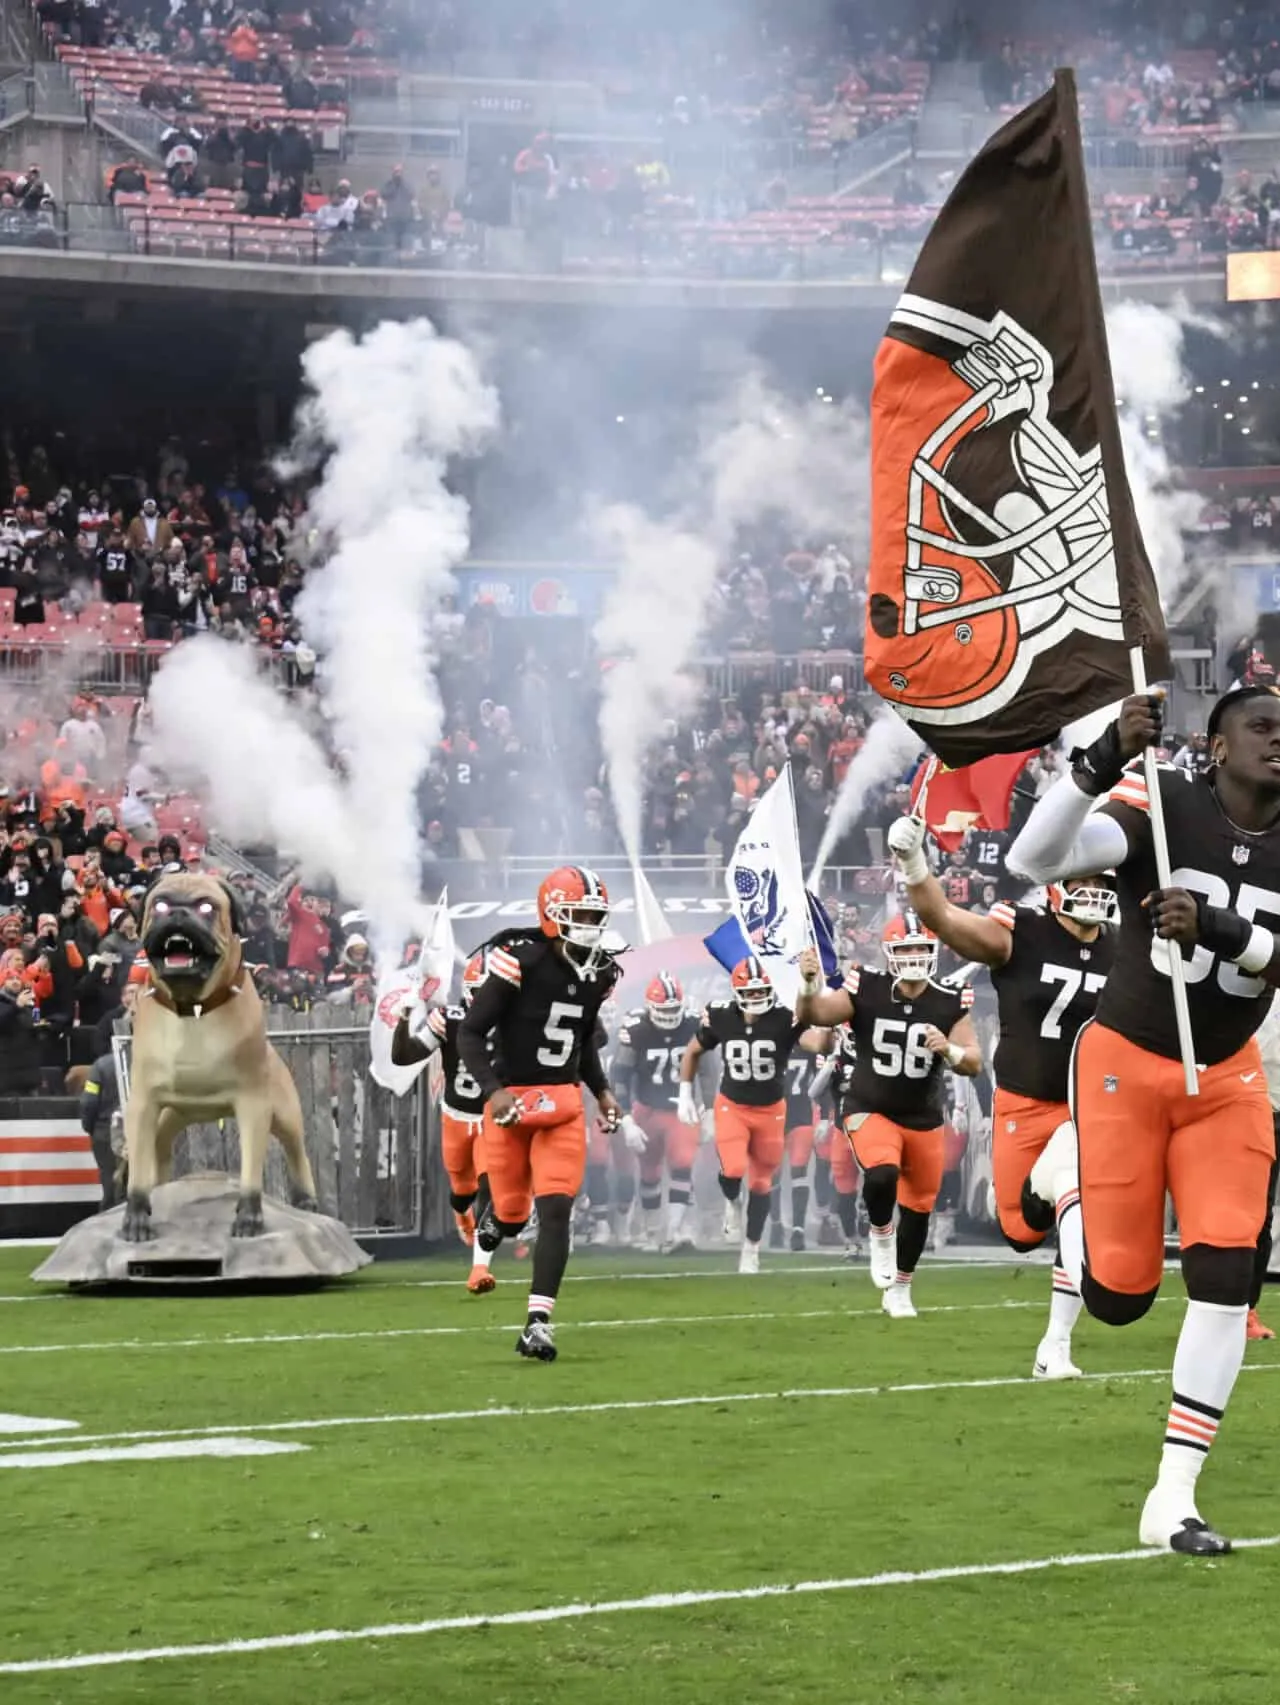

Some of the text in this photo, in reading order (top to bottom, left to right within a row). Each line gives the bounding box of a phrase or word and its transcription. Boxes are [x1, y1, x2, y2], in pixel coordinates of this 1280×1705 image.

[107, 552, 127, 571] 57
[231, 575, 248, 592] 16
[978, 842, 999, 864] 12
[537, 1001, 584, 1067] 5
[872, 1017, 934, 1078] 56
[725, 1039, 776, 1081] 86
